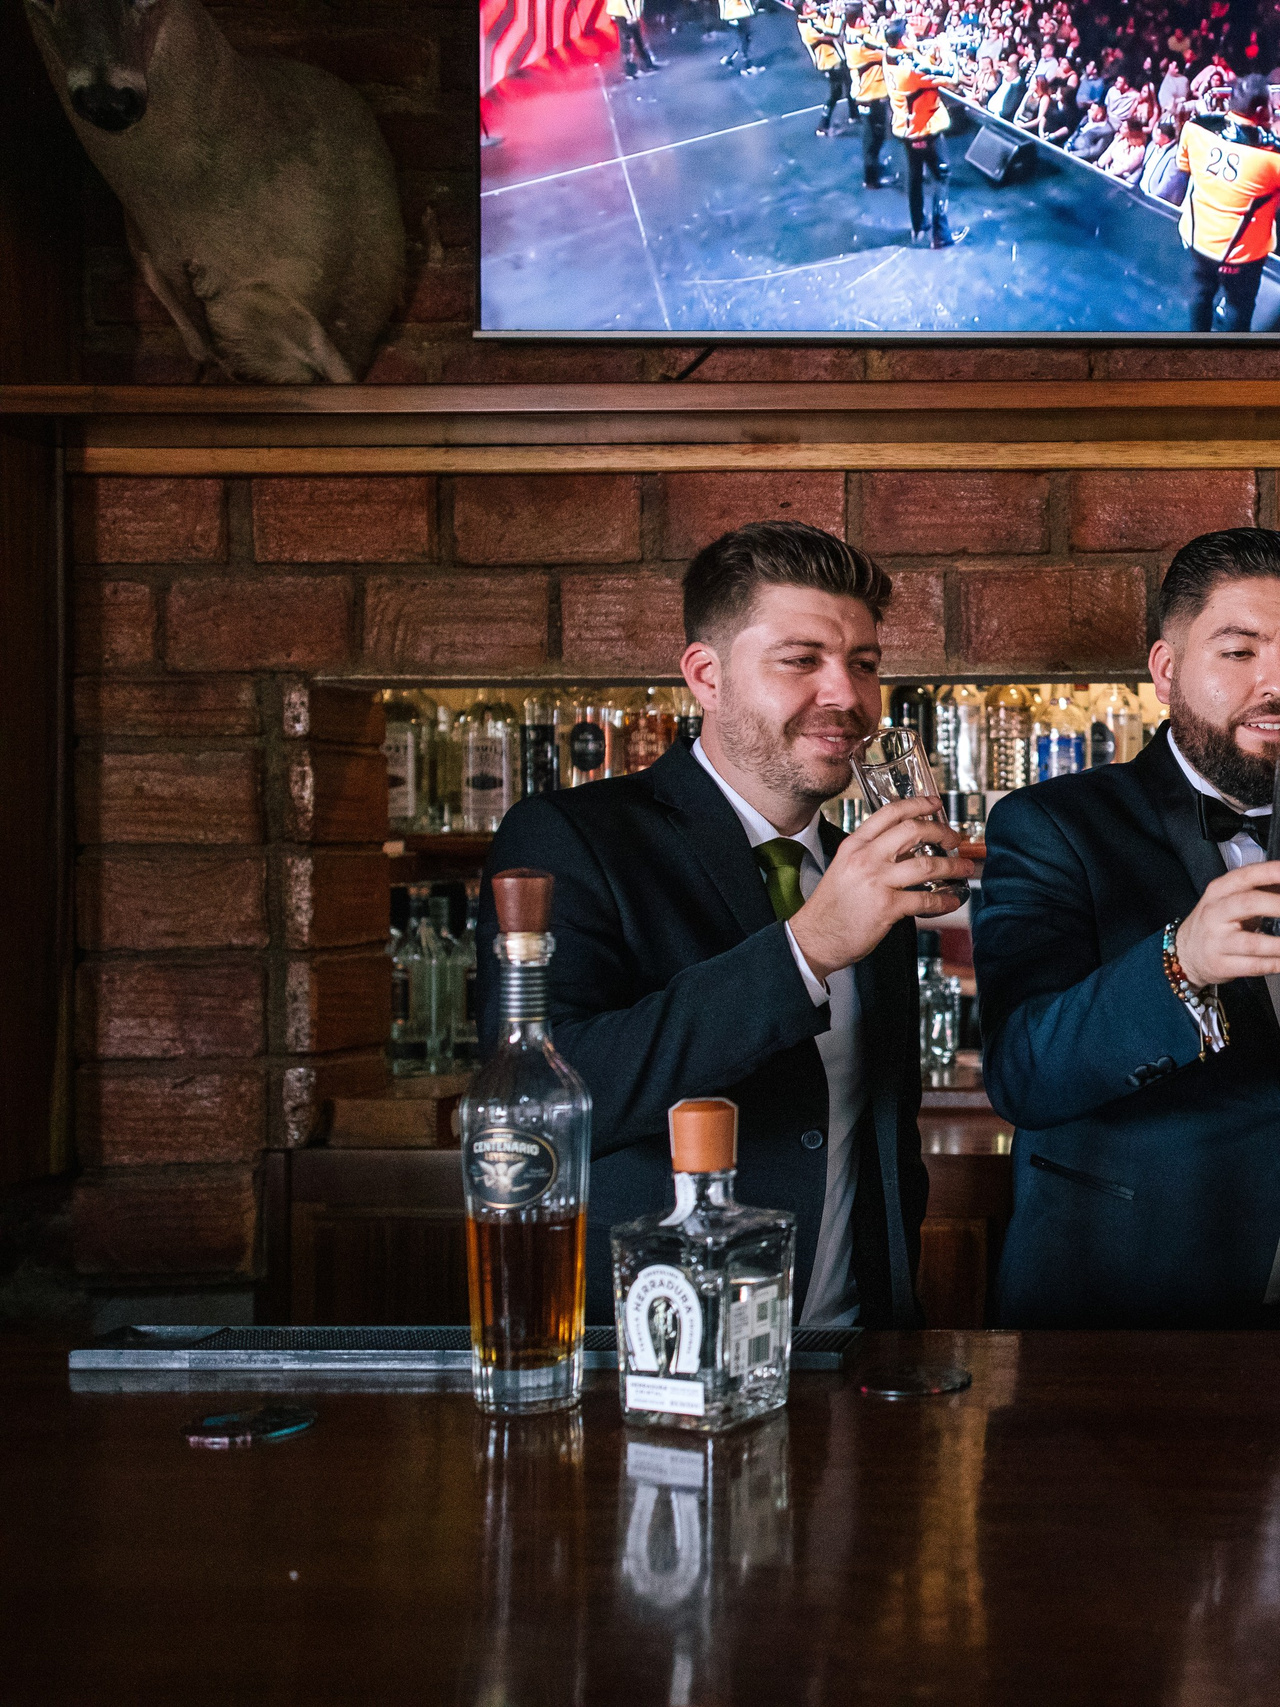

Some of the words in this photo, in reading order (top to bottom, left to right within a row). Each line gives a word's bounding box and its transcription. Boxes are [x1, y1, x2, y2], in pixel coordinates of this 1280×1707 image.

[1206, 147, 1240, 182] 28
[473, 1141, 540, 1156] CENTENARIO
[633, 1278, 693, 1315] HERRADURA
